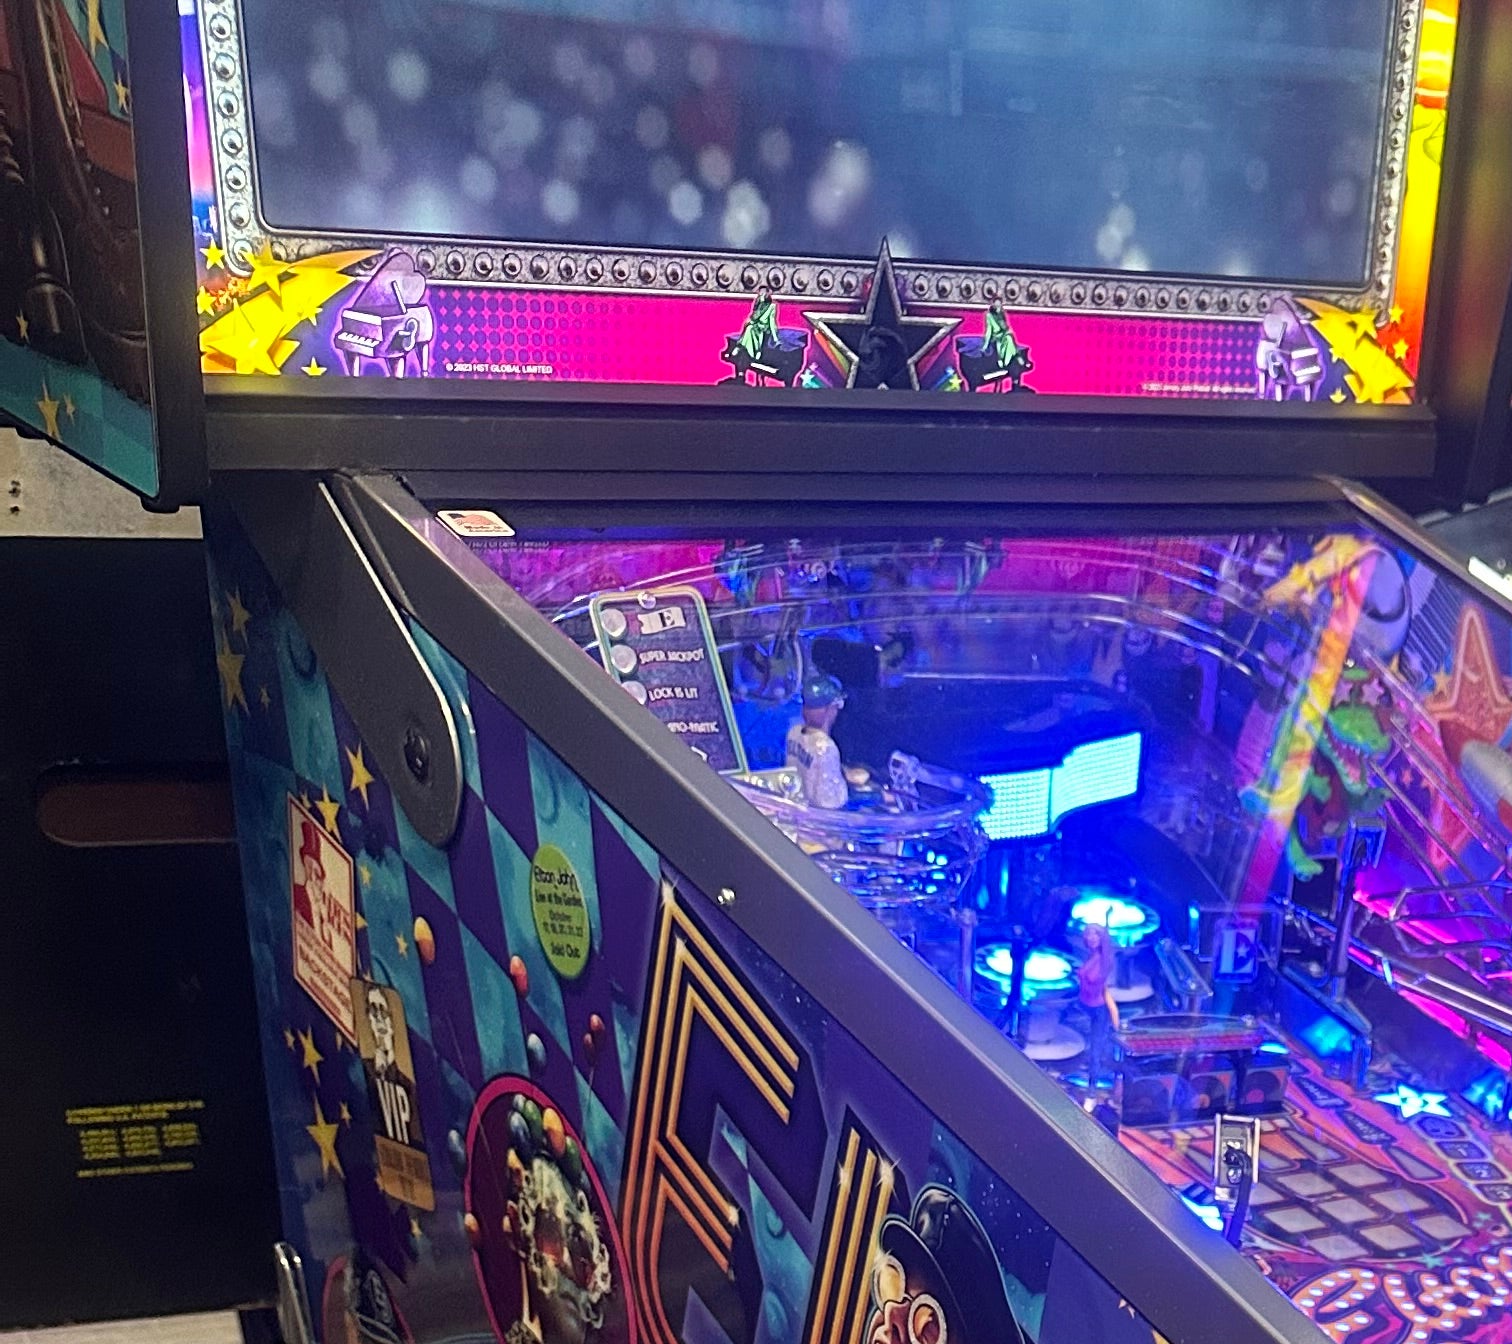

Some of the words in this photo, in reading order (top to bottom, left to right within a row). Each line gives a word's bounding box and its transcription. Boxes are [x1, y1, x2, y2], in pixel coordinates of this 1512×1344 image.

[490, 363, 521, 374] GLOBAL
[522, 364, 553, 375] LIMITED
[648, 687, 675, 702] LOCK
[684, 687, 699, 699] LIT
[533, 864, 556, 885] Elton
[375, 1077, 411, 1146] VIP
